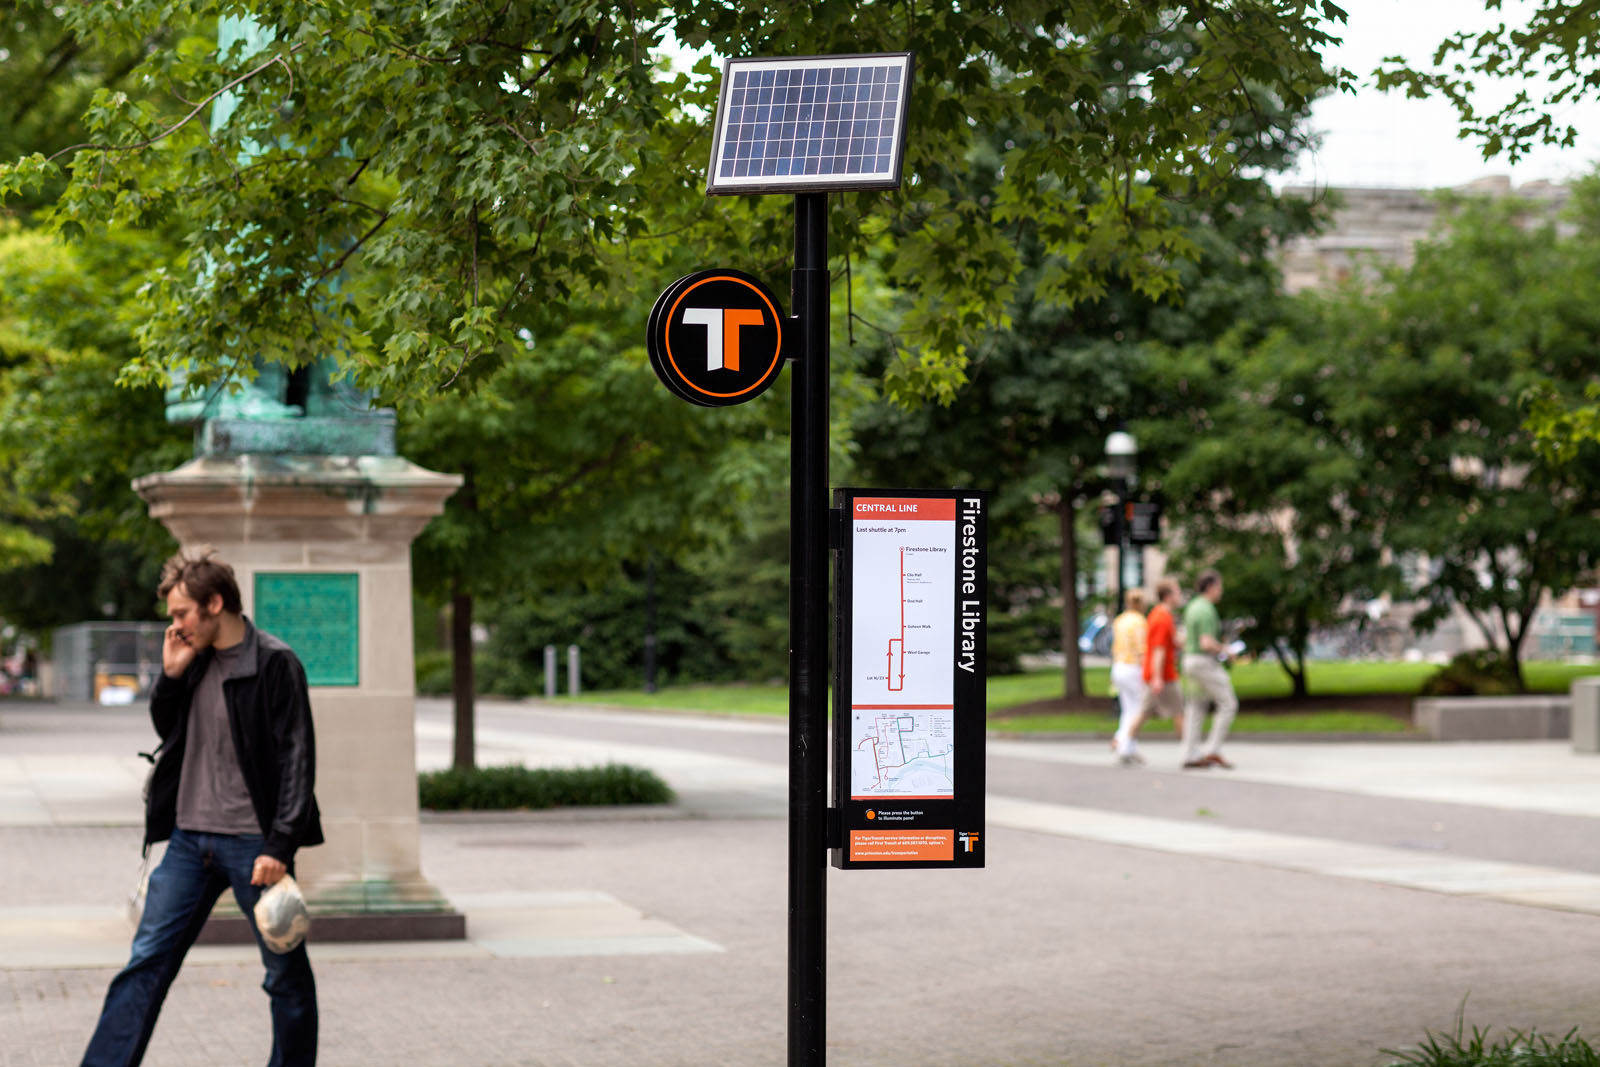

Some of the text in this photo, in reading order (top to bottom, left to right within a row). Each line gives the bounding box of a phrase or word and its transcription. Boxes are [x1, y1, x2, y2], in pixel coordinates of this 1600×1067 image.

[856, 503, 918, 513] CENTRAL LINE
[958, 498, 980, 673] Firestone Library
